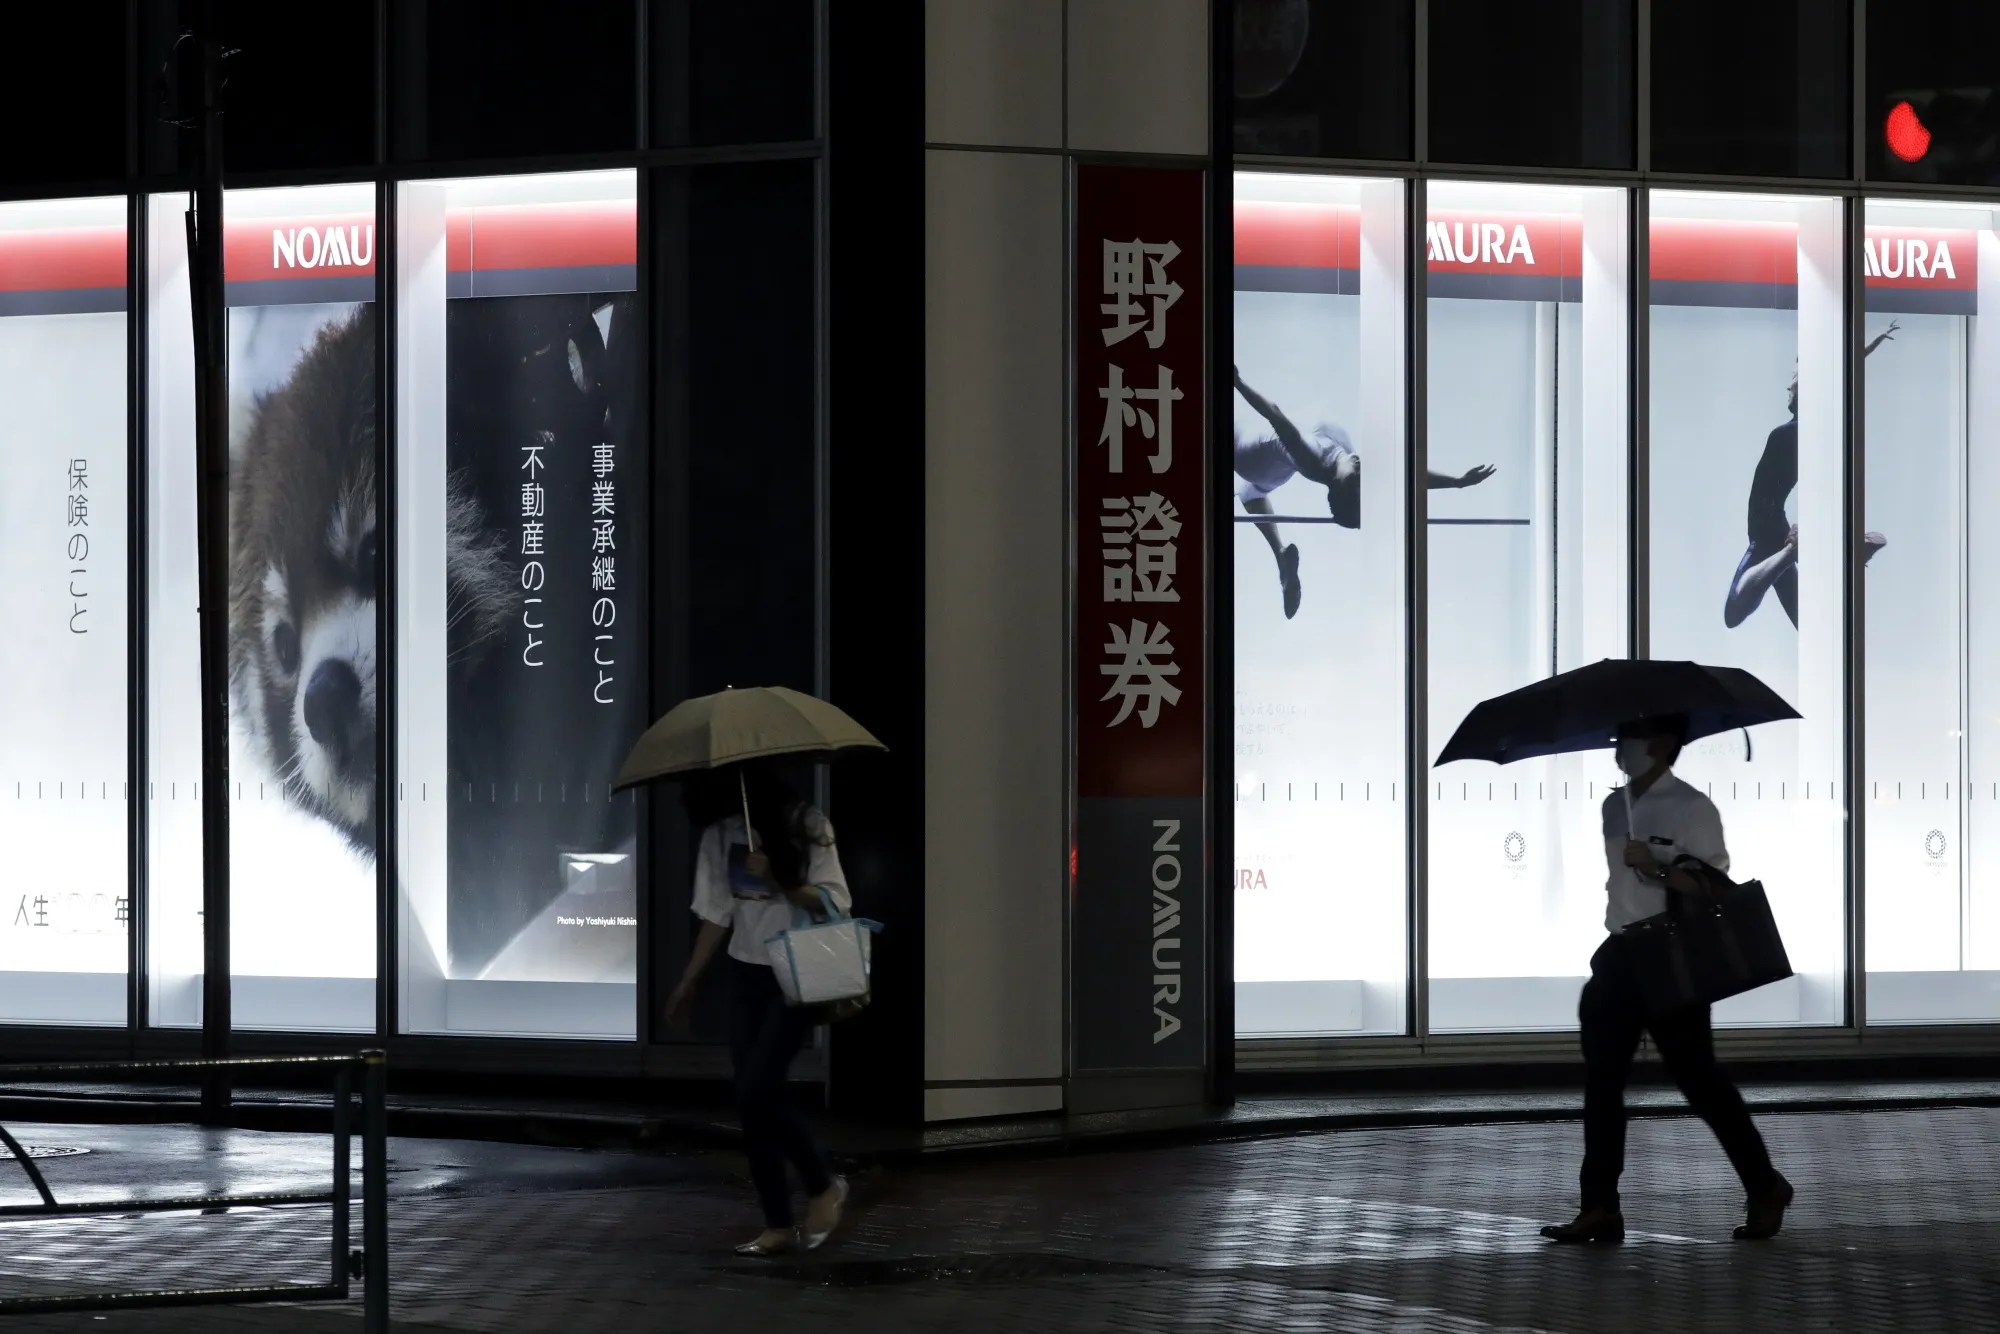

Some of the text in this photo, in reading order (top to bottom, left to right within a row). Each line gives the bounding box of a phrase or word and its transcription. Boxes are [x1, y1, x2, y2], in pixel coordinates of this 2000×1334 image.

[273, 225, 373, 269] NOMU
[67, 458, 89, 636] 保険のこと
[521, 445, 545, 669] 不動産のこと
[591, 443, 616, 707] 事業承継のこと
[1099, 238, 1186, 731] 野村證券
[557, 915, 576, 925] Photo
[576, 916, 585, 928] by
[585, 916, 616, 928] Yoshiyuki
[1152, 819, 1181, 1045] NOMURA
